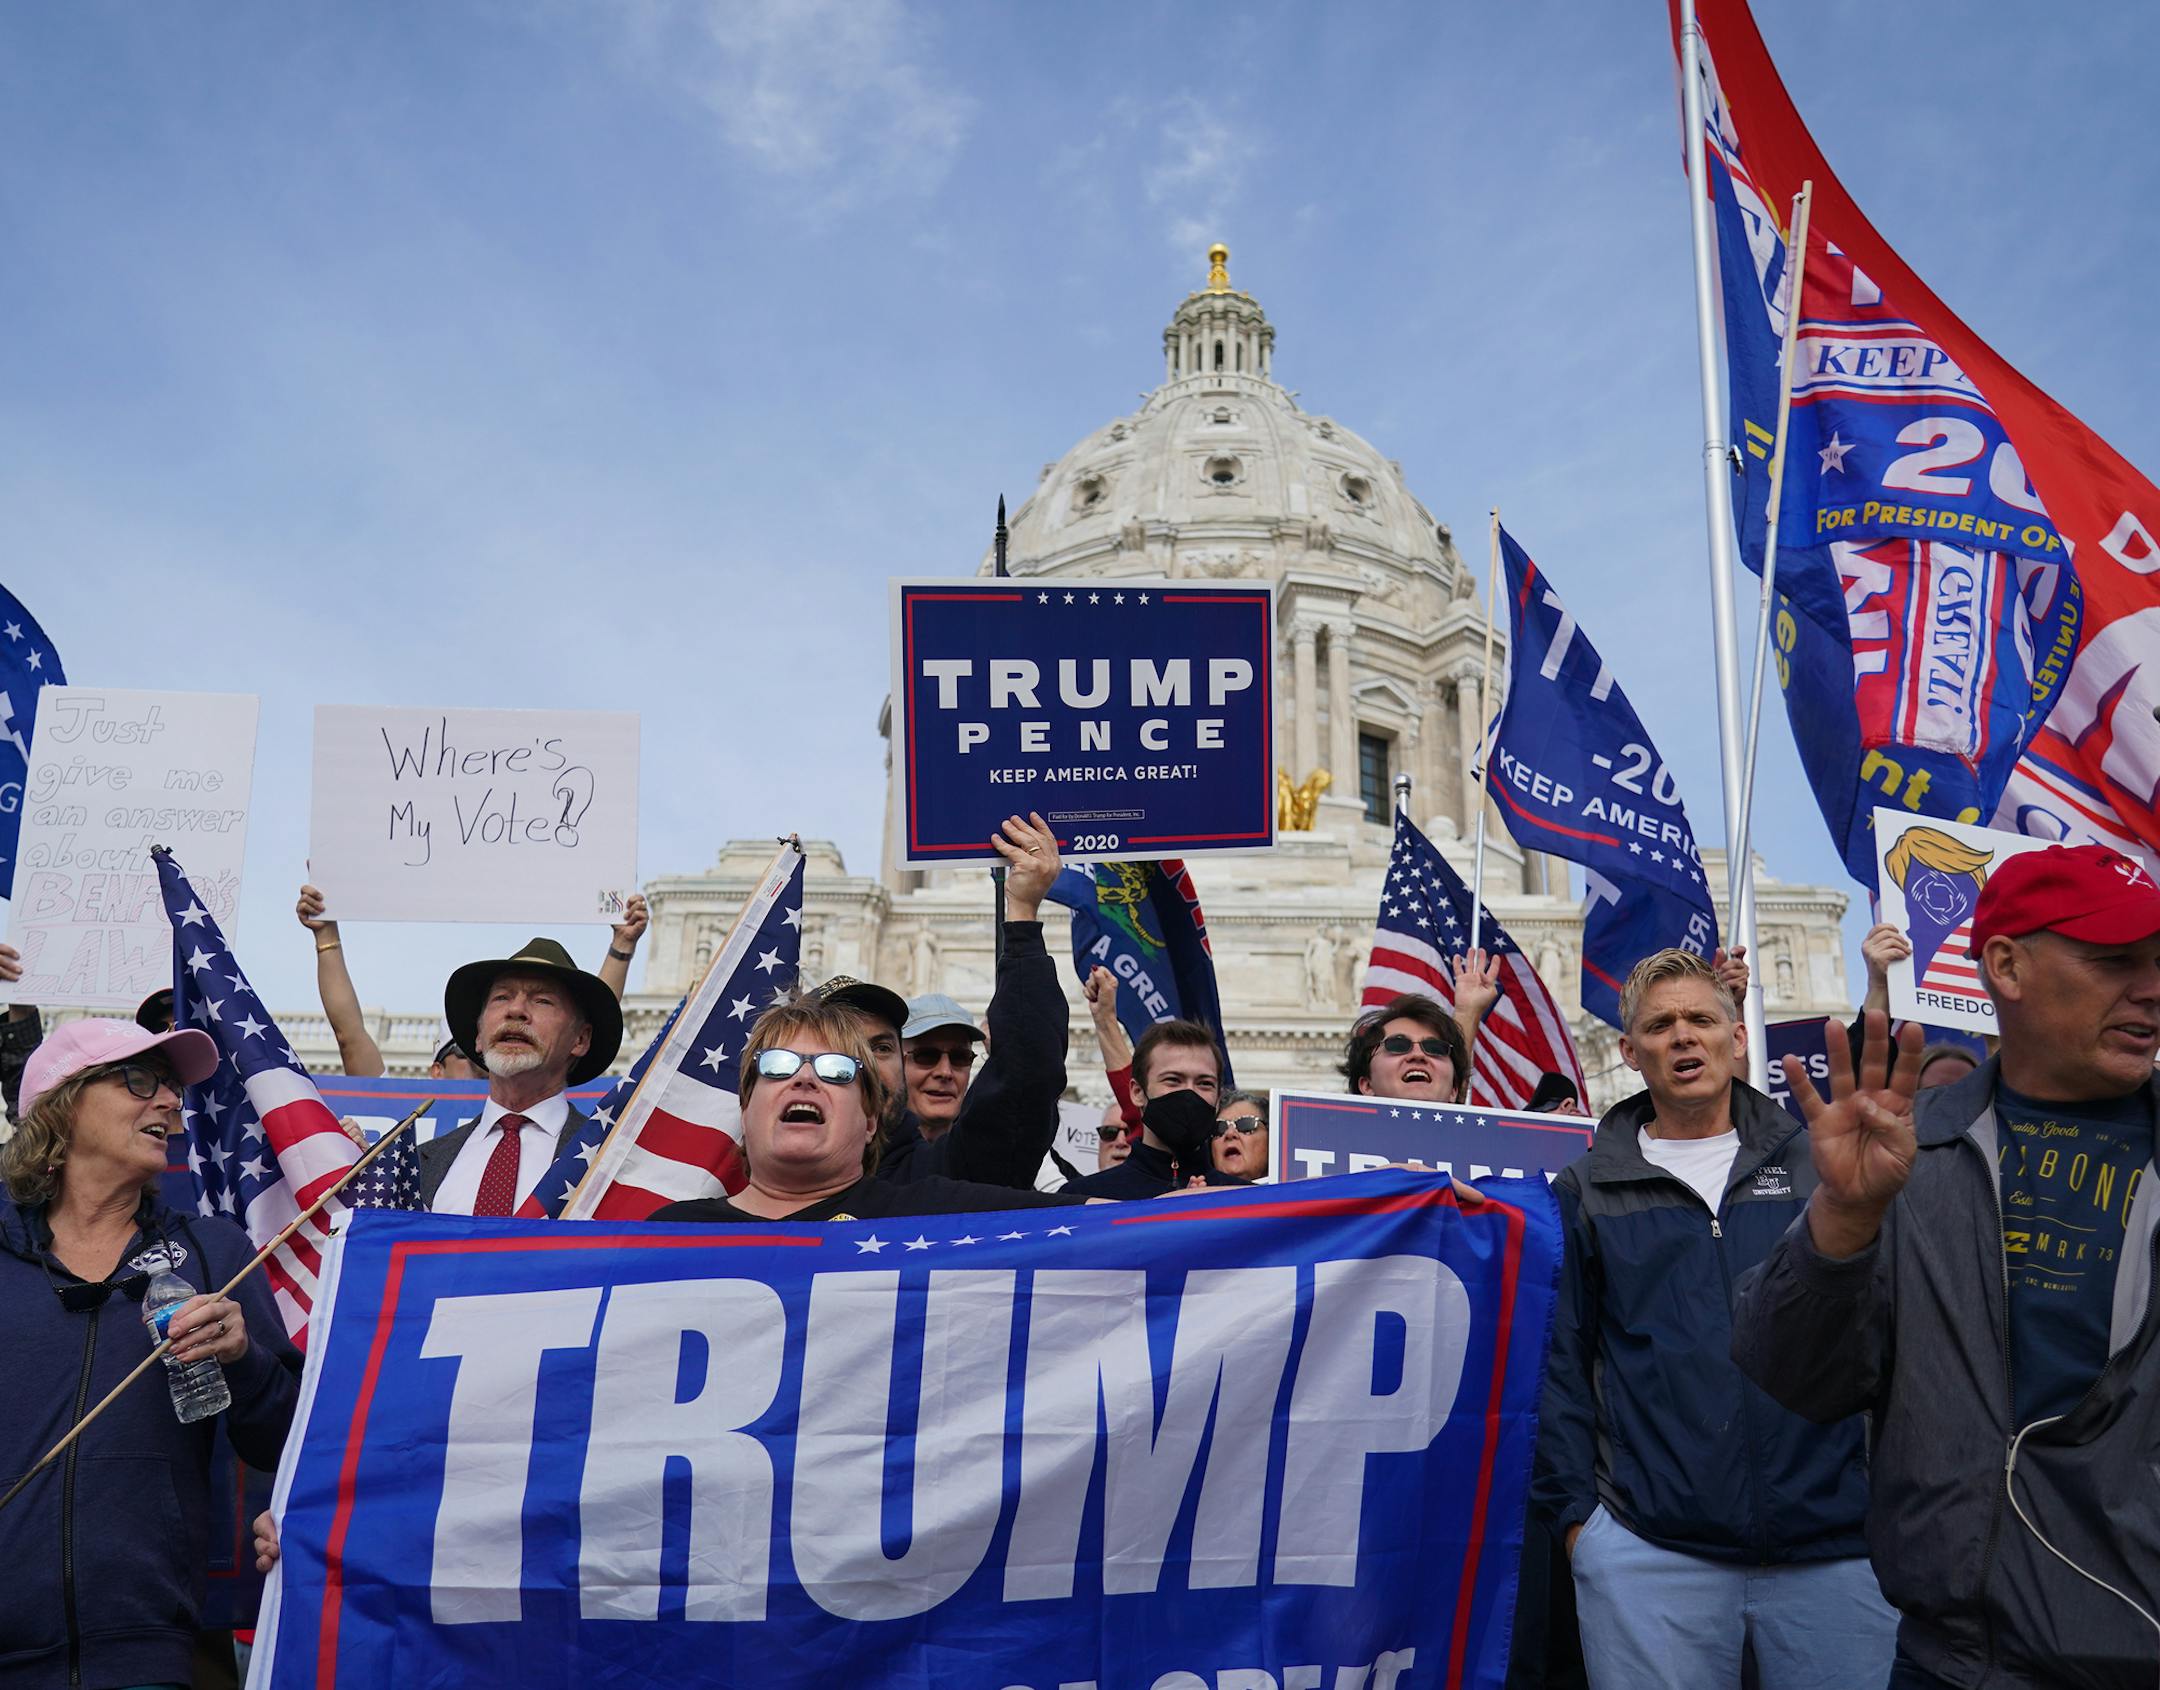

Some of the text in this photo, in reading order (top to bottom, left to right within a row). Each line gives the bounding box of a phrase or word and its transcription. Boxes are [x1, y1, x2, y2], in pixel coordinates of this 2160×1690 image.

[1816, 344, 1950, 379] KEEP
[1816, 501, 2061, 553] FOR PRESIDENT OF
[922, 657, 1254, 710] TRUMP
[49, 698, 164, 744] Just
[957, 718, 1226, 754] PENCE
[381, 716, 567, 781] Where's
[29, 756, 132, 802] give
[163, 767, 223, 791] me
[989, 764, 1198, 784] KEEP AMERICA GREAT!
[1500, 747, 1573, 807] KEEP
[32, 805, 244, 833] an answer
[389, 800, 431, 867] My
[24, 834, 154, 871] about
[1073, 834, 1119, 851] 2020
[13, 929, 173, 994] LAW
[1067, 1127, 1098, 1146] VOTE
[2040, 1120, 2080, 1138] Goods
[2036, 1232, 2086, 1260] MRK
[420, 1254, 1471, 1625] TRUMP
